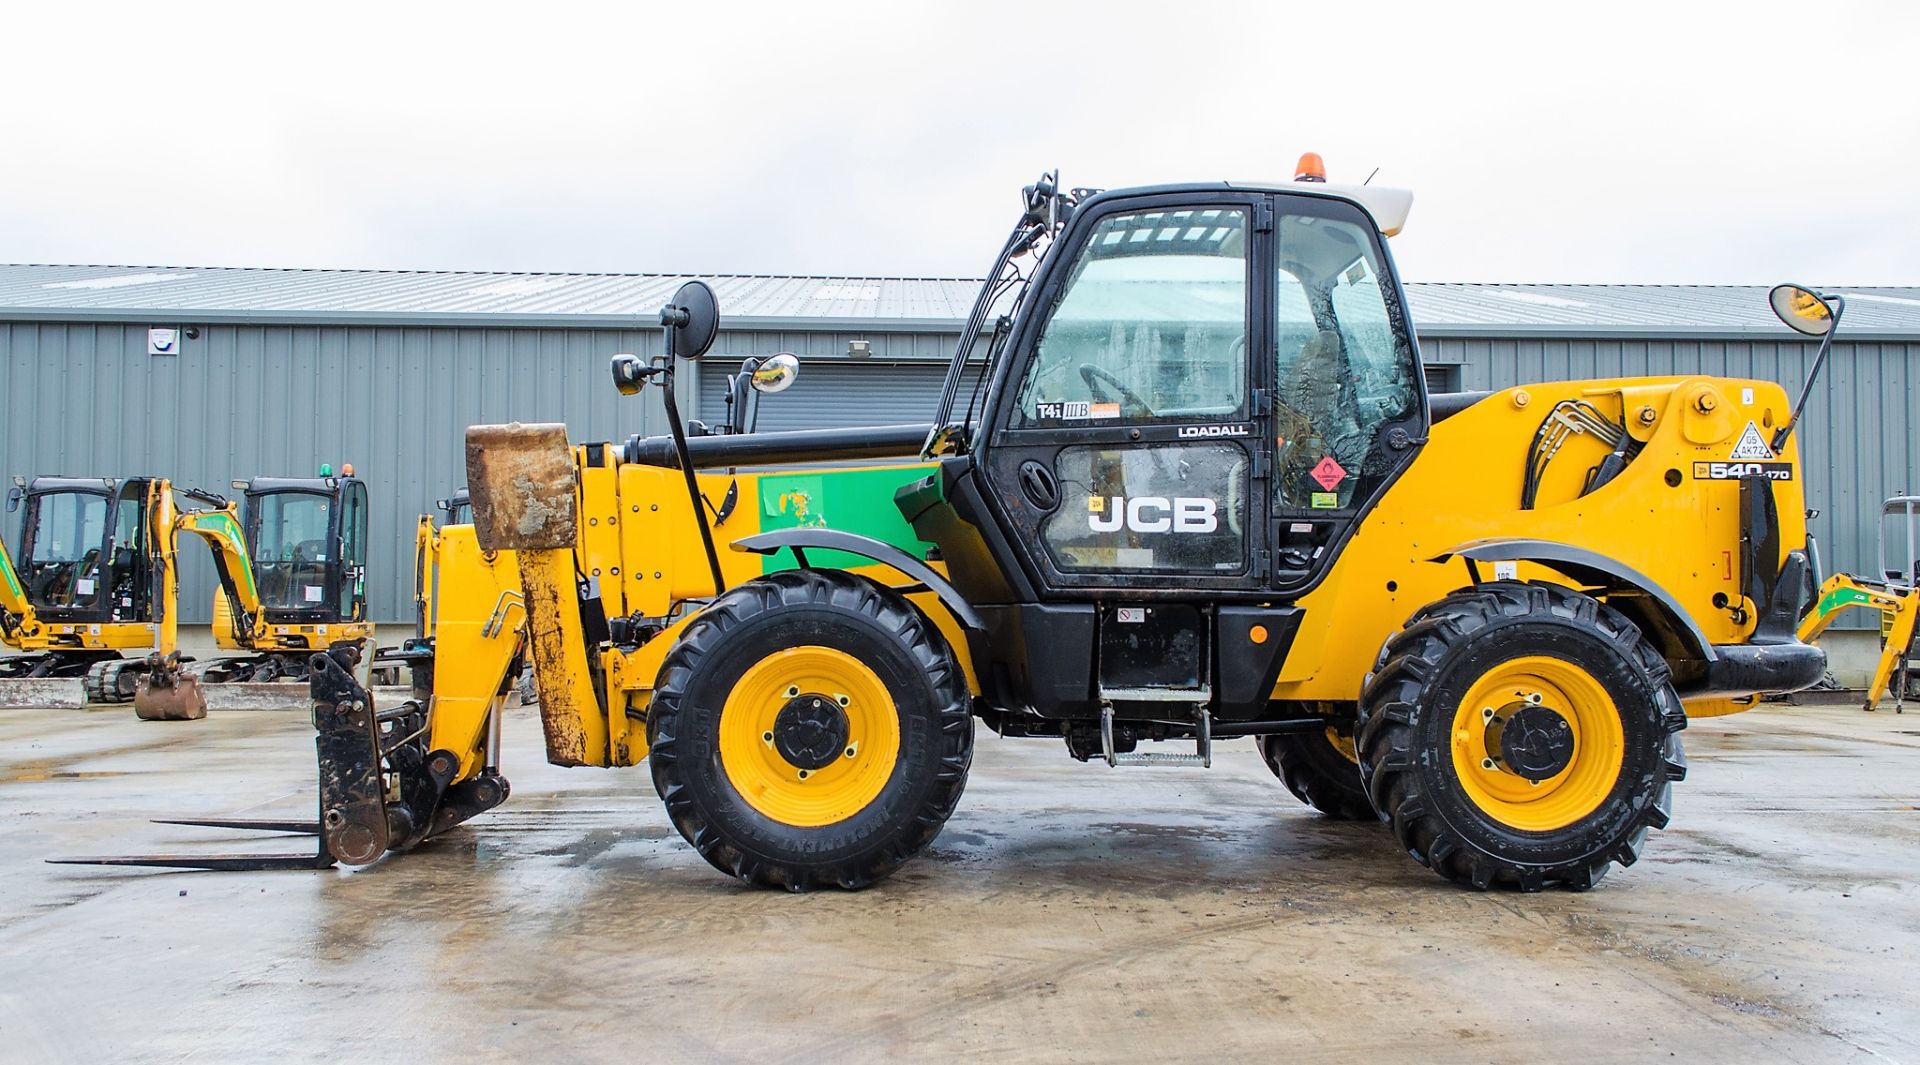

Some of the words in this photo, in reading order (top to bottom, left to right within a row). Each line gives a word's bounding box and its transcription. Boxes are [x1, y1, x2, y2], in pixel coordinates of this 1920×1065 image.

[1037, 404, 1062, 419] T4i
[1178, 426, 1249, 438] LOADALL
[1088, 496, 1218, 533] JCB
